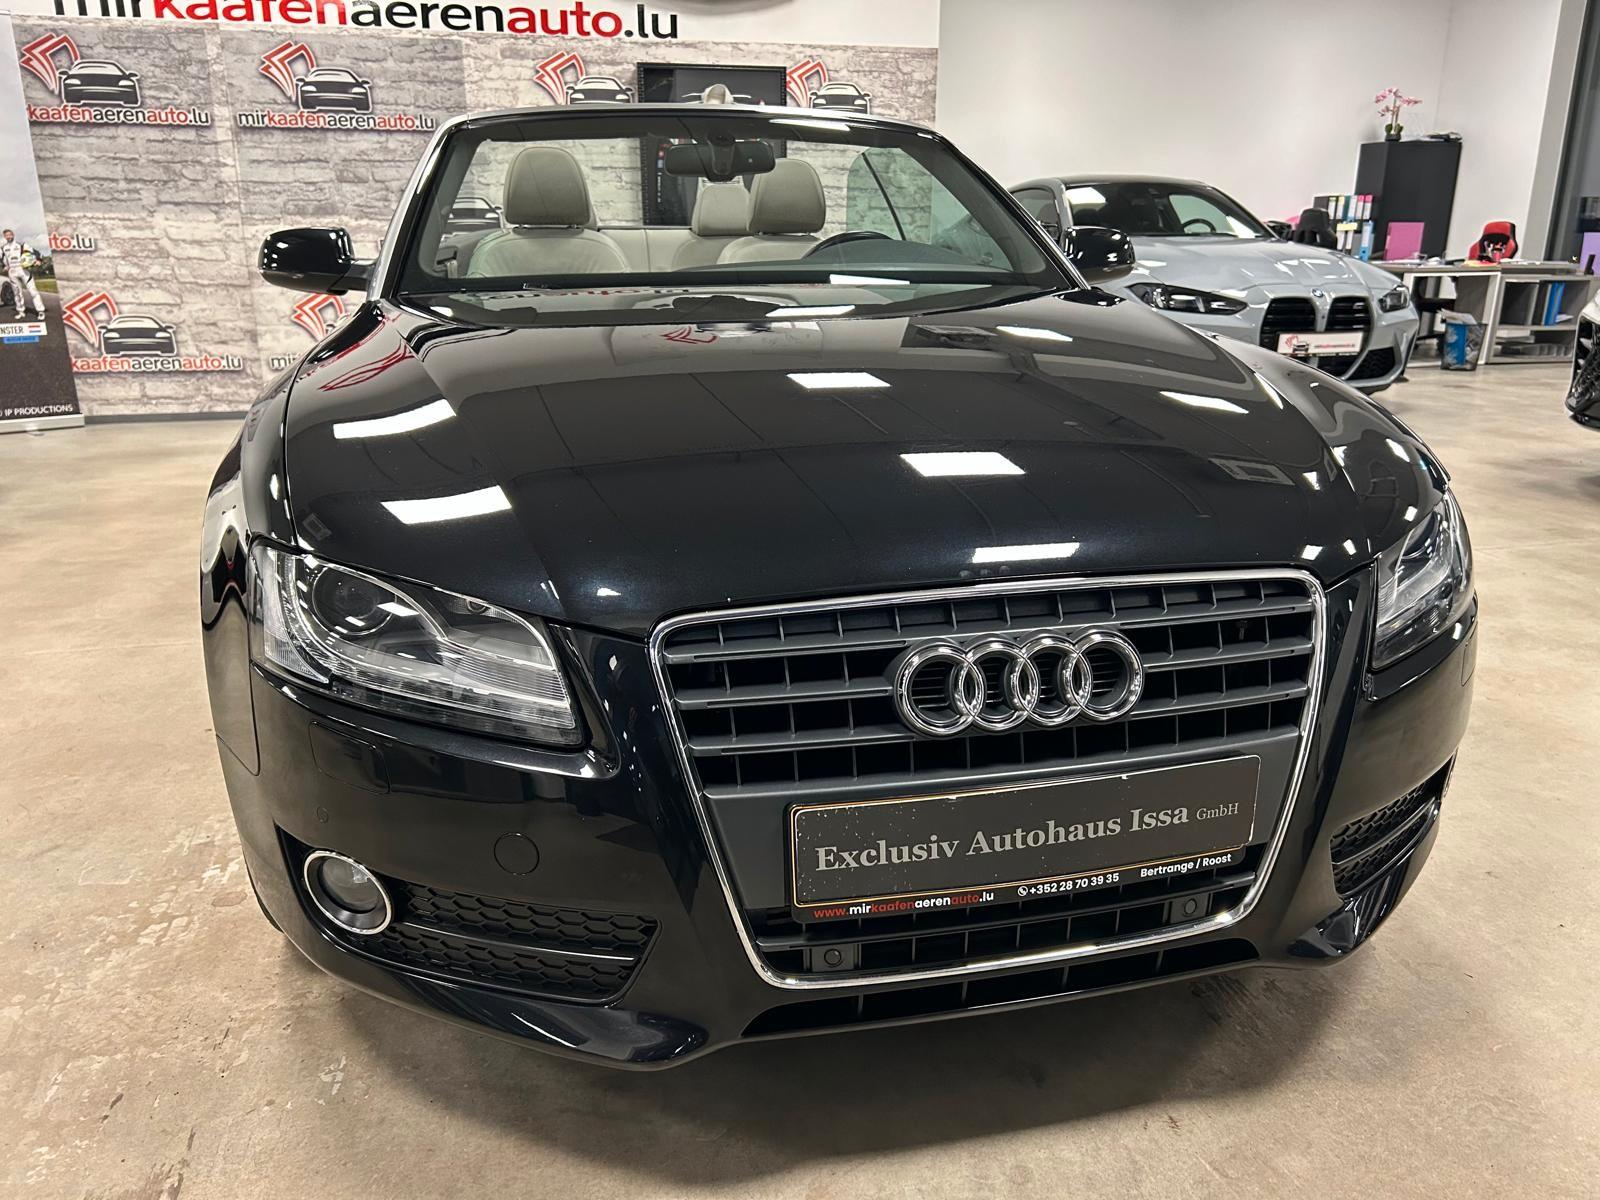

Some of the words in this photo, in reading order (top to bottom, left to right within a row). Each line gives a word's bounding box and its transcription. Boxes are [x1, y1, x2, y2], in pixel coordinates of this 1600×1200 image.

[27, 104, 209, 125] kaafenaerenauto.lu
[238, 110, 434, 130] mirkaafenaerenauto.lu
[14, 404, 73, 416] PRODUCTIONS
[815, 834, 960, 871] Exclusiv
[965, 820, 1121, 856] Autohaus
[1129, 807, 1189, 832] Issa
[1196, 803, 1239, 820] GmbH
[1140, 861, 1194, 878] Bertrange
[1202, 853, 1232, 867] Roost
[1029, 883, 1058, 895] +352
[1059, 880, 1073, 892] 28
[1075, 878, 1089, 889] 70
[1090, 875, 1104, 886] 39
[1105, 873, 1120, 884] 35
[814, 891, 994, 918] www.mirkaafenaerenauto.lu
